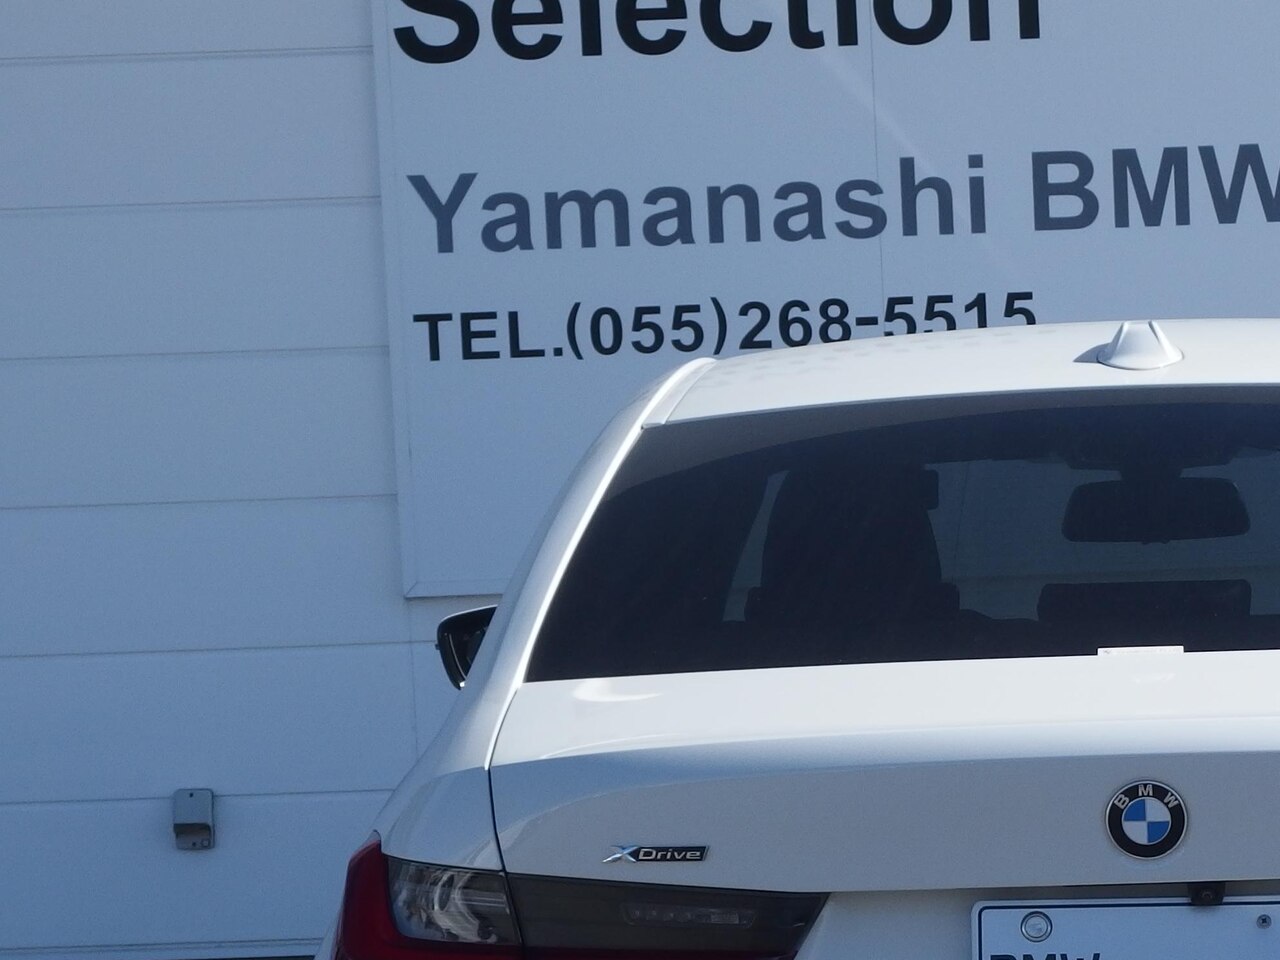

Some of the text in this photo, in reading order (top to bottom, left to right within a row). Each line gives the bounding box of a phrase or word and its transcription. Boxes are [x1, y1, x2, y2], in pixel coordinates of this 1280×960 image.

[406, 154, 987, 254] Yamanashi
[412, 291, 1037, 362] TEL.(055)268-5515
[1113, 783, 1180, 810] BMW
